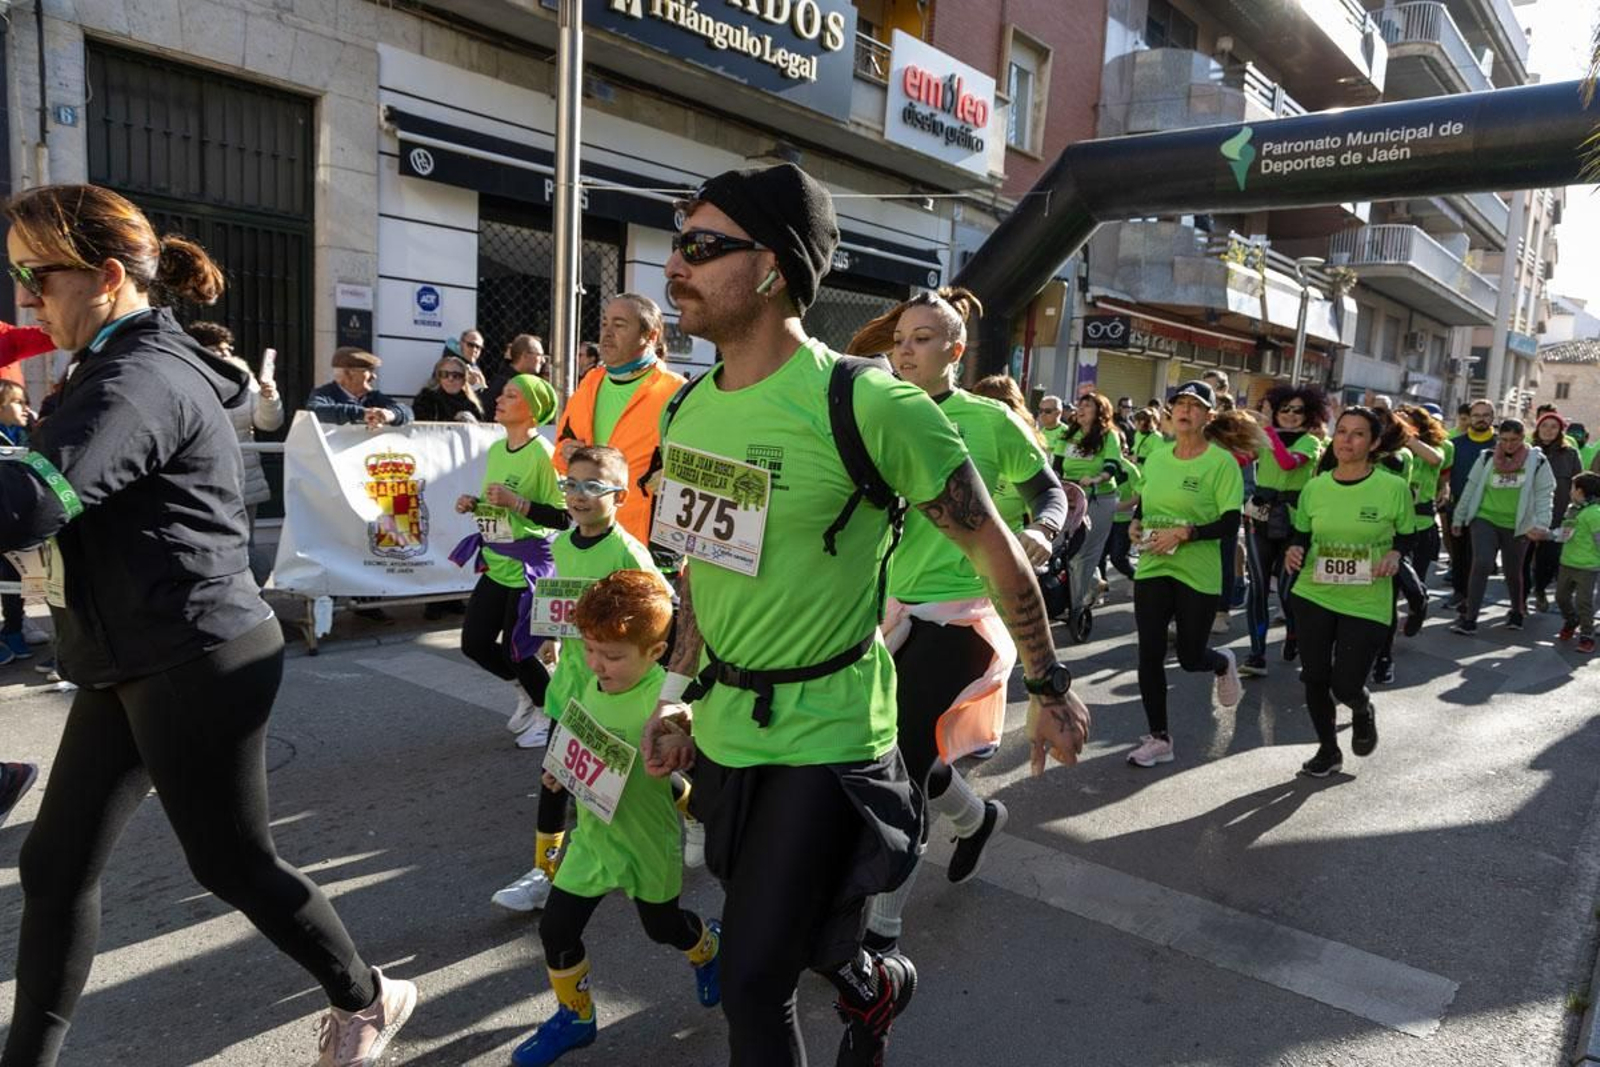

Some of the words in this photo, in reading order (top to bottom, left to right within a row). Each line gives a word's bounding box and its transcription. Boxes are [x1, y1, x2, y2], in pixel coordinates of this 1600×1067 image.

[763, 34, 817, 81] Legal
[945, 125, 984, 152] gráfico
[1262, 136, 1341, 156] Patronato
[1346, 121, 1434, 147] Municipal
[1438, 120, 1463, 136] de
[1261, 156, 1335, 174] Deportes
[1340, 151, 1362, 165] de
[1367, 146, 1411, 163] Jaén
[682, 451, 695, 466] SAN
[675, 487, 738, 541] 375
[1324, 559, 1356, 575] 608
[550, 599, 577, 623] 96
[564, 738, 606, 788] 967
